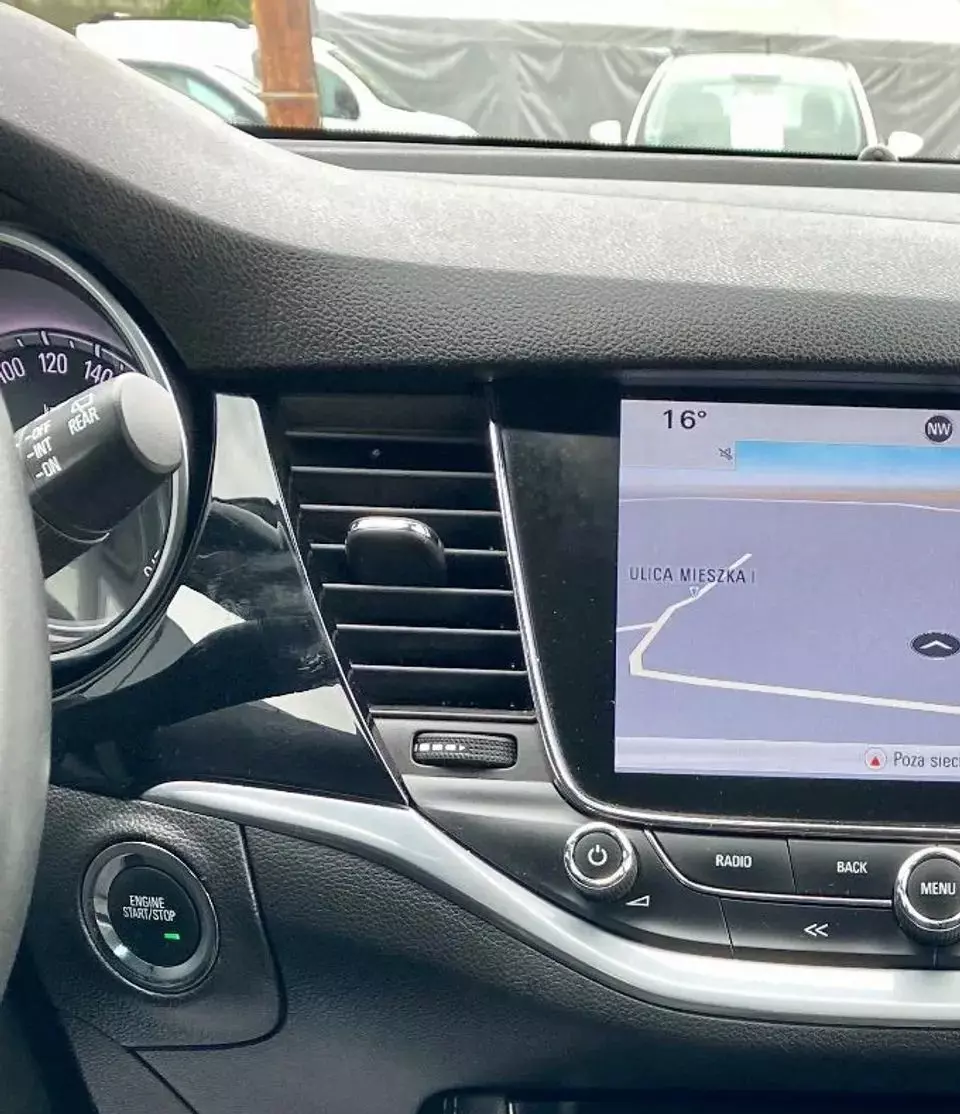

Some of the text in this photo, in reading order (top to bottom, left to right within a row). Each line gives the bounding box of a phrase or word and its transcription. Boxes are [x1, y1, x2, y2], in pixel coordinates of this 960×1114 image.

[38, 352, 68, 374] 120
[67, 407, 101, 435] REAR
[663, 409, 708, 430] 16°
[926, 420, 952, 437] NW
[629, 567, 673, 581] ULICA
[680, 567, 746, 583] MIESZKA
[893, 750, 925, 768] Poza
[715, 853, 753, 869] RADIO
[836, 860, 868, 875] BACK
[920, 881, 956, 897] MENU
[129, 895, 165, 909] ENGINE
[122, 906, 176, 922] START/STOP
